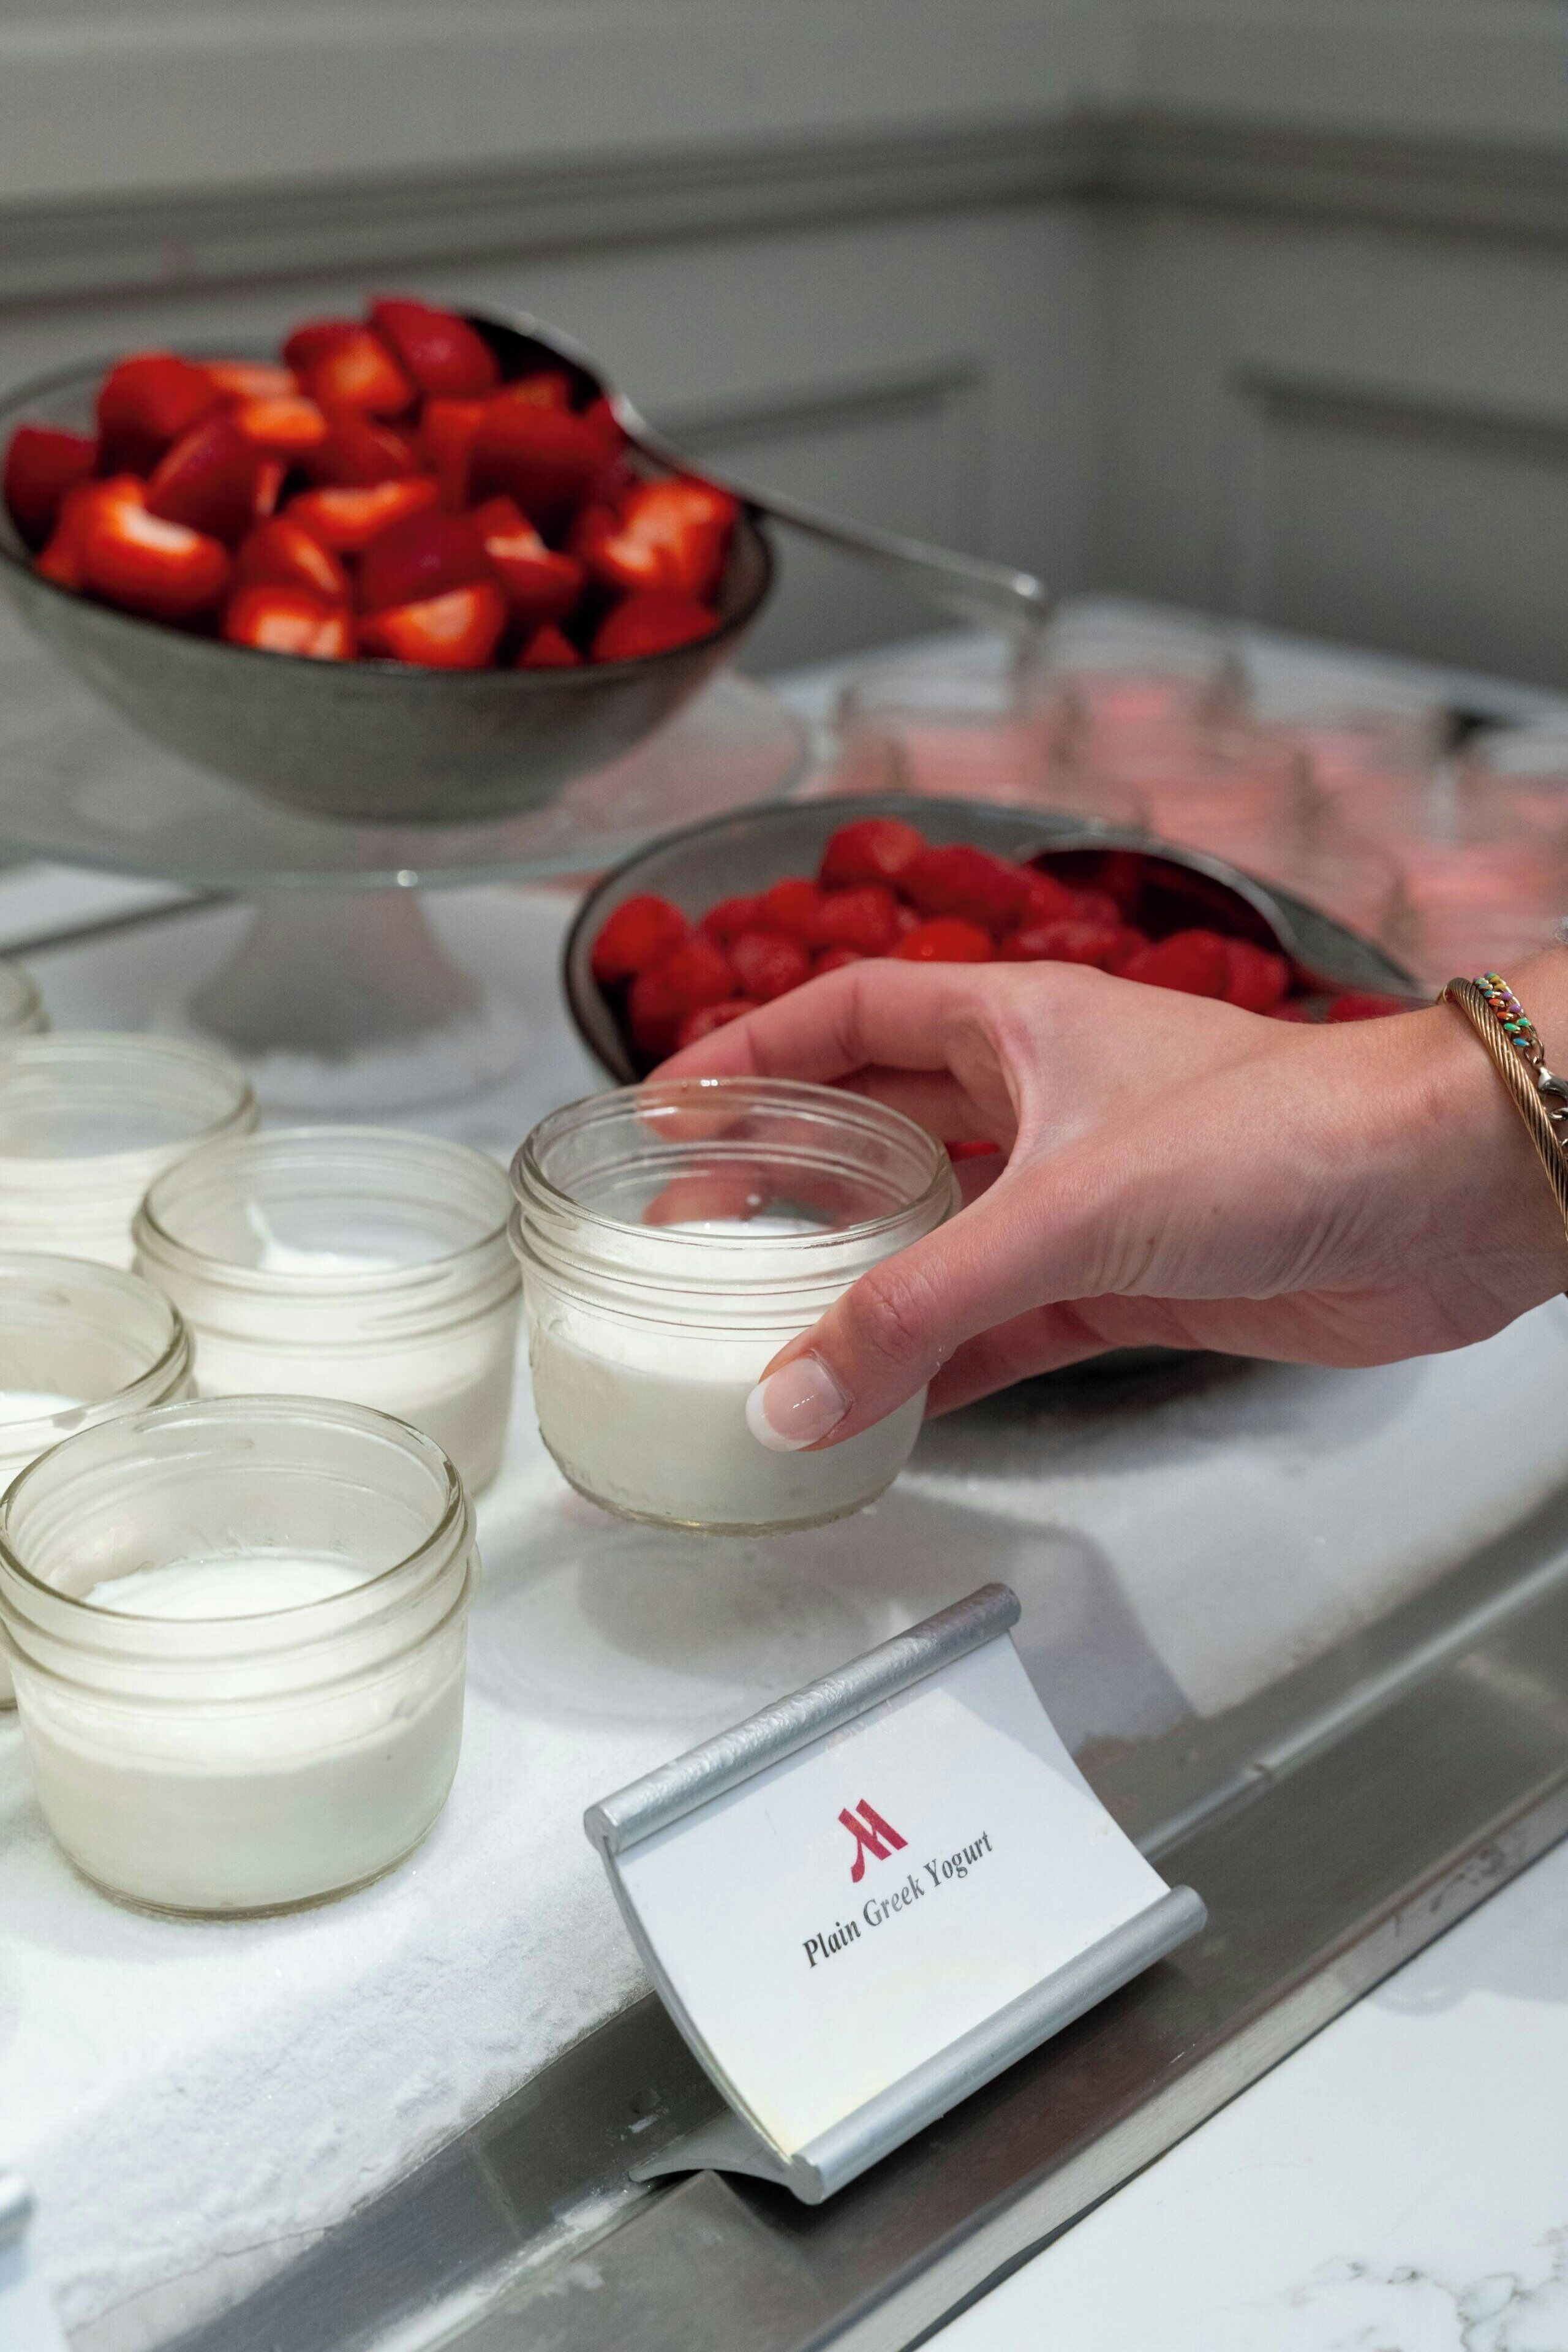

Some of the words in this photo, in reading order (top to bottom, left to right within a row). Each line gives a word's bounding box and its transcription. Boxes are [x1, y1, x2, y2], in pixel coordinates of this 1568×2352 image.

[802, 1921, 861, 1968] Plain
[863, 1875, 925, 1927] Greek
[924, 1831, 992, 1887] Yogurt
